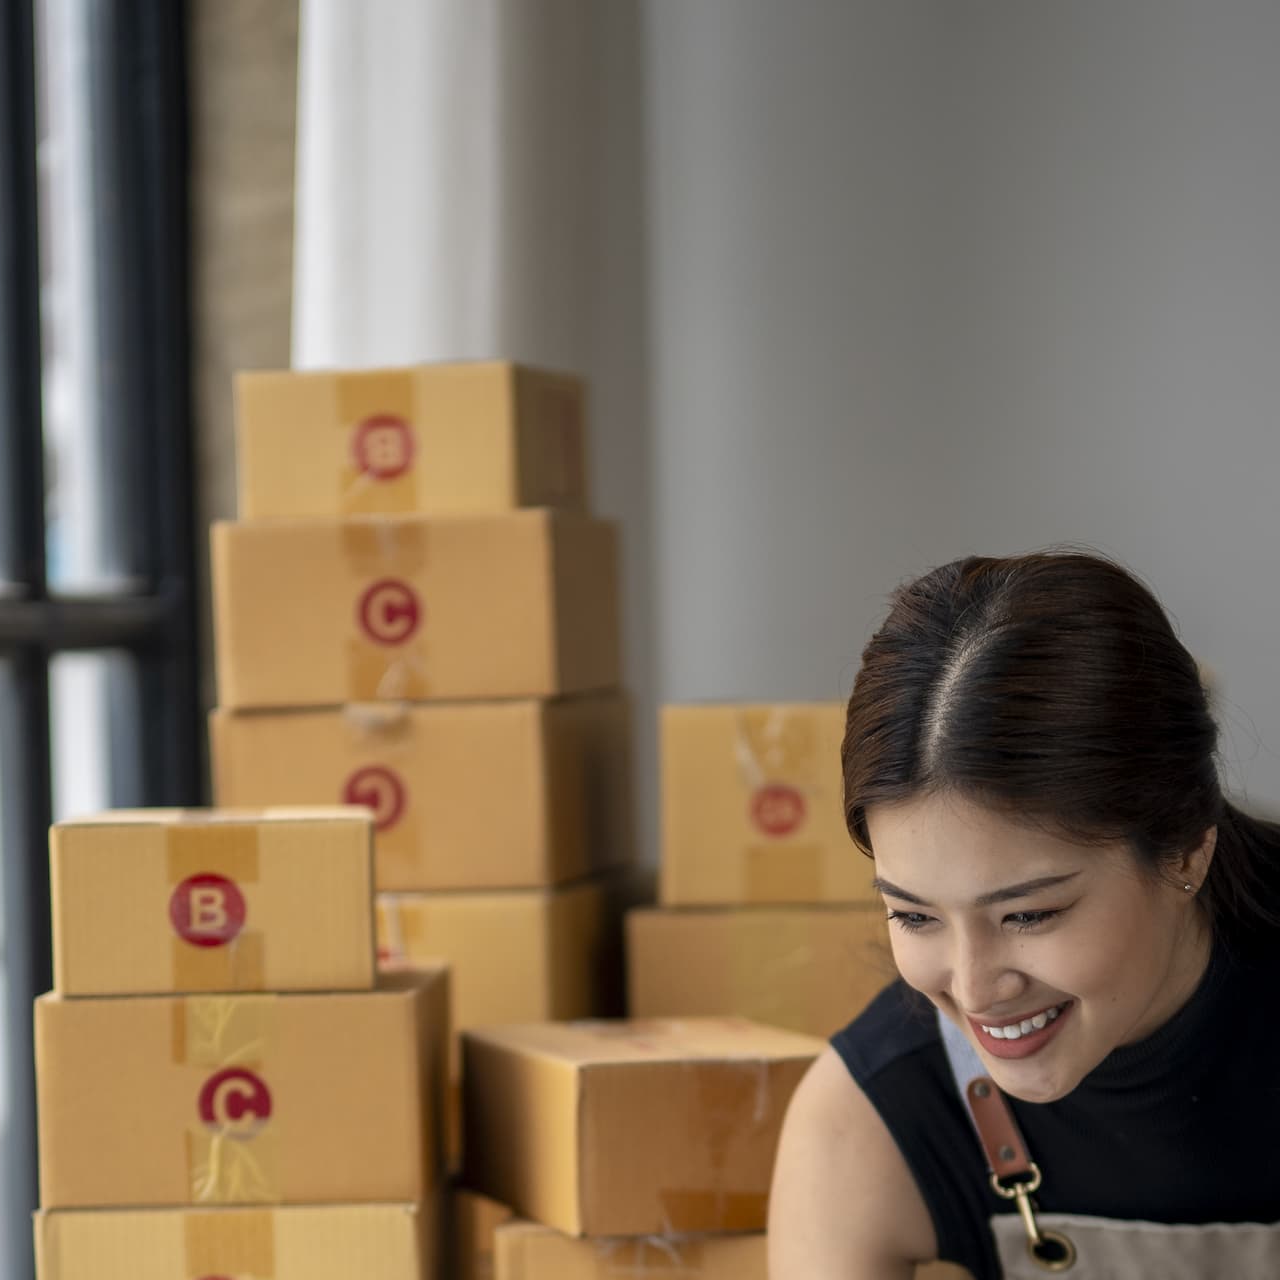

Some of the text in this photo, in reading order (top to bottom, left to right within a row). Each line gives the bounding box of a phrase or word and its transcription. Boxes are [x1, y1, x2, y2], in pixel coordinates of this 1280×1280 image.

[370, 588, 408, 637] C
[190, 888, 228, 931] B
[213, 1078, 256, 1133] C
